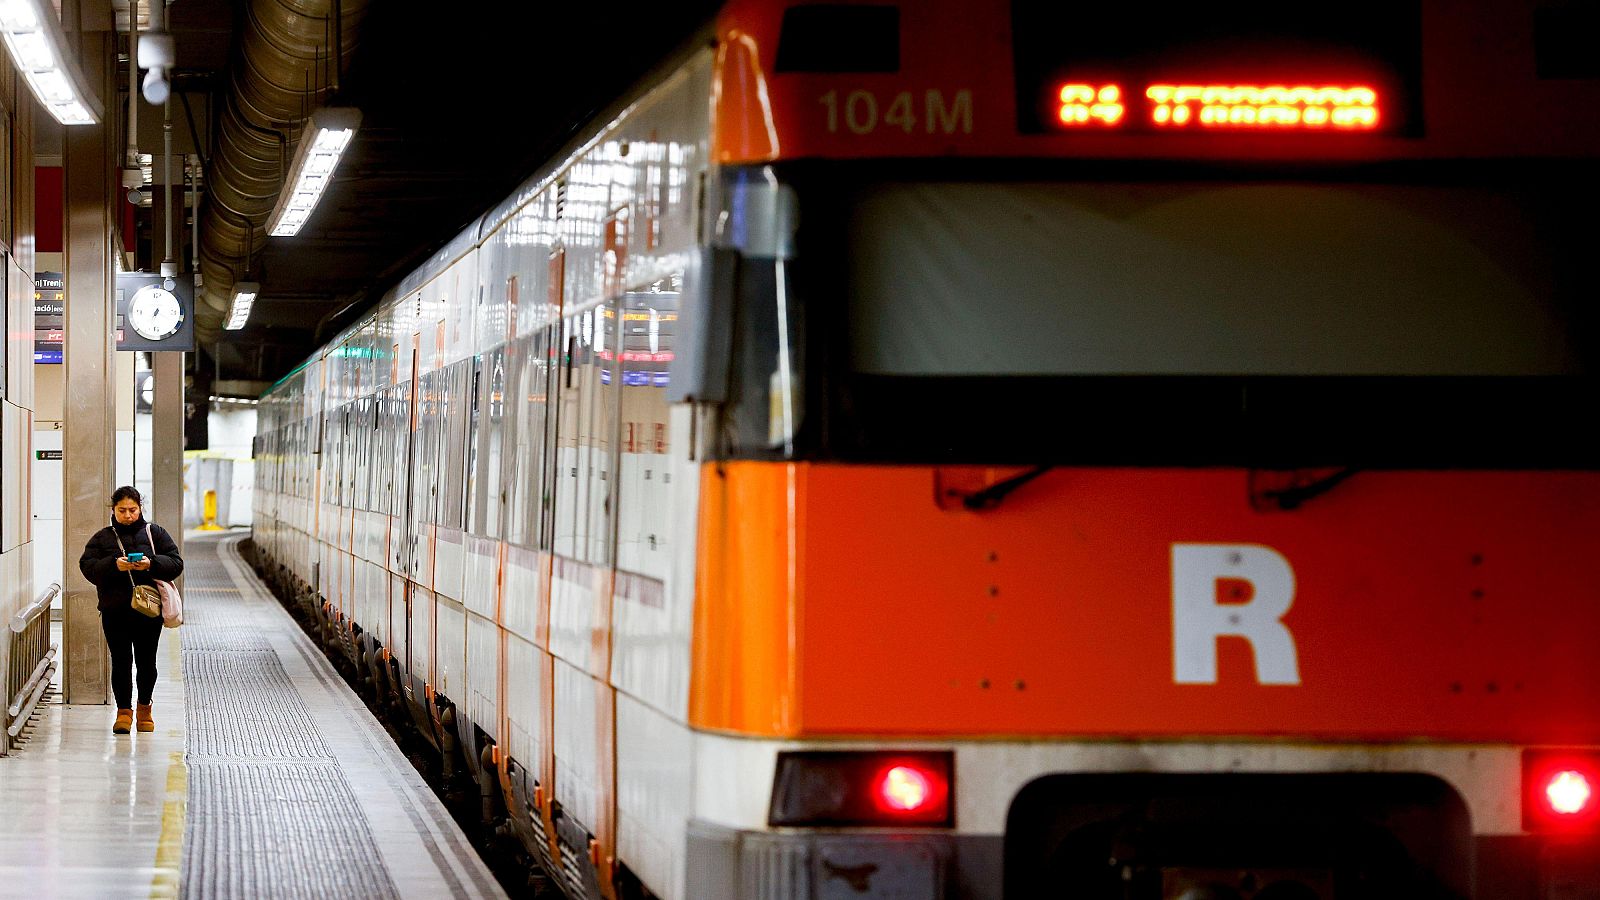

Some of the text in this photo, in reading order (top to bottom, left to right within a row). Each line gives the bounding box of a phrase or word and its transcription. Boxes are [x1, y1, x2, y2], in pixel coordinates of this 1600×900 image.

[817, 87, 974, 135] 104M
[1060, 84, 1123, 124] R4
[1171, 542, 1301, 685] R
